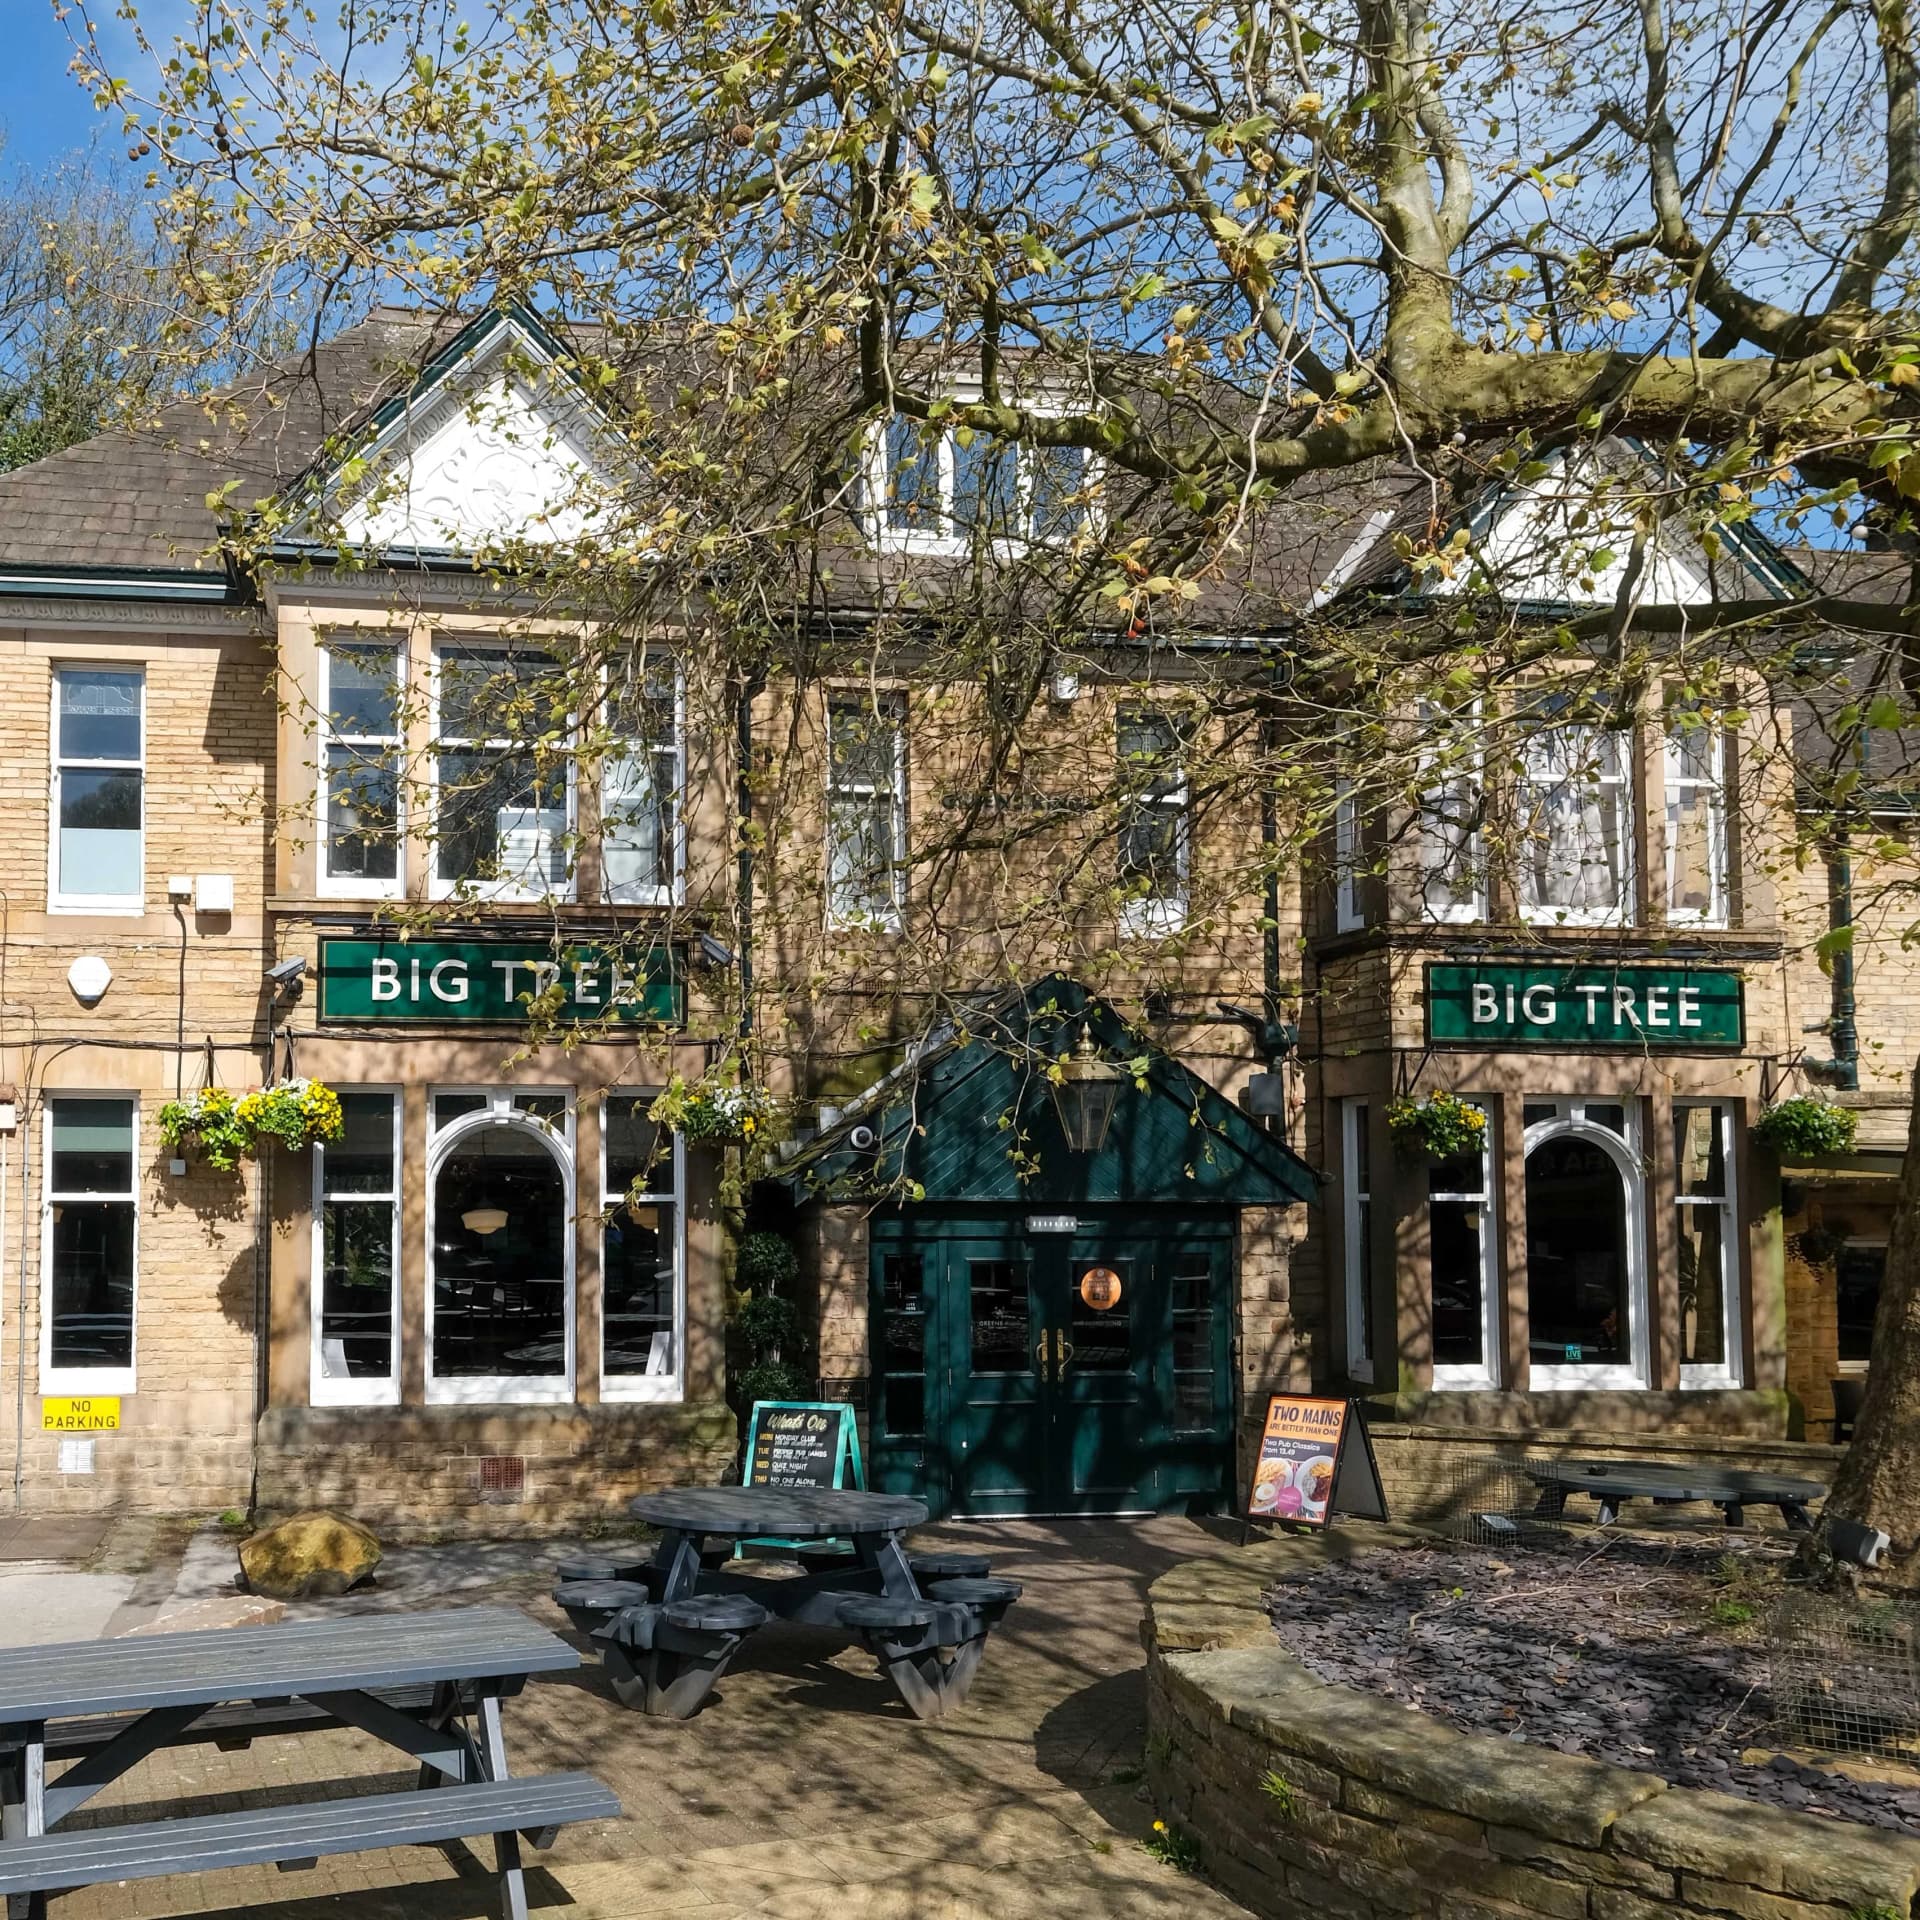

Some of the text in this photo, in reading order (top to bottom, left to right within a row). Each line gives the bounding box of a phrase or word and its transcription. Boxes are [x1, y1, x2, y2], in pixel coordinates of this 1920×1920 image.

[371, 958, 470, 1003] BIG
[1471, 983, 1703, 1027] BIG TREE
[71, 1400, 91, 1413] NO
[44, 1415, 116, 1428] PARKING
[1273, 1405, 1342, 1427] TWO MAINS
[806, 1414, 828, 1432] On
[1281, 1424, 1305, 1433] BETTER
[1305, 1426, 1321, 1435] THAN
[1322, 1428, 1339, 1436] ONE
[774, 1433, 800, 1442] MONDAY
[800, 1435, 817, 1443] CLUB
[758, 1447, 770, 1455] TUE
[1263, 1446, 1278, 1454] from
[1278, 1440, 1291, 1448] Pub
[1292, 1441, 1321, 1451] Classics
[771, 1461, 788, 1469] QUIZ
[789, 1462, 808, 1471] NIGHT
[770, 1476, 780, 1484] NO
